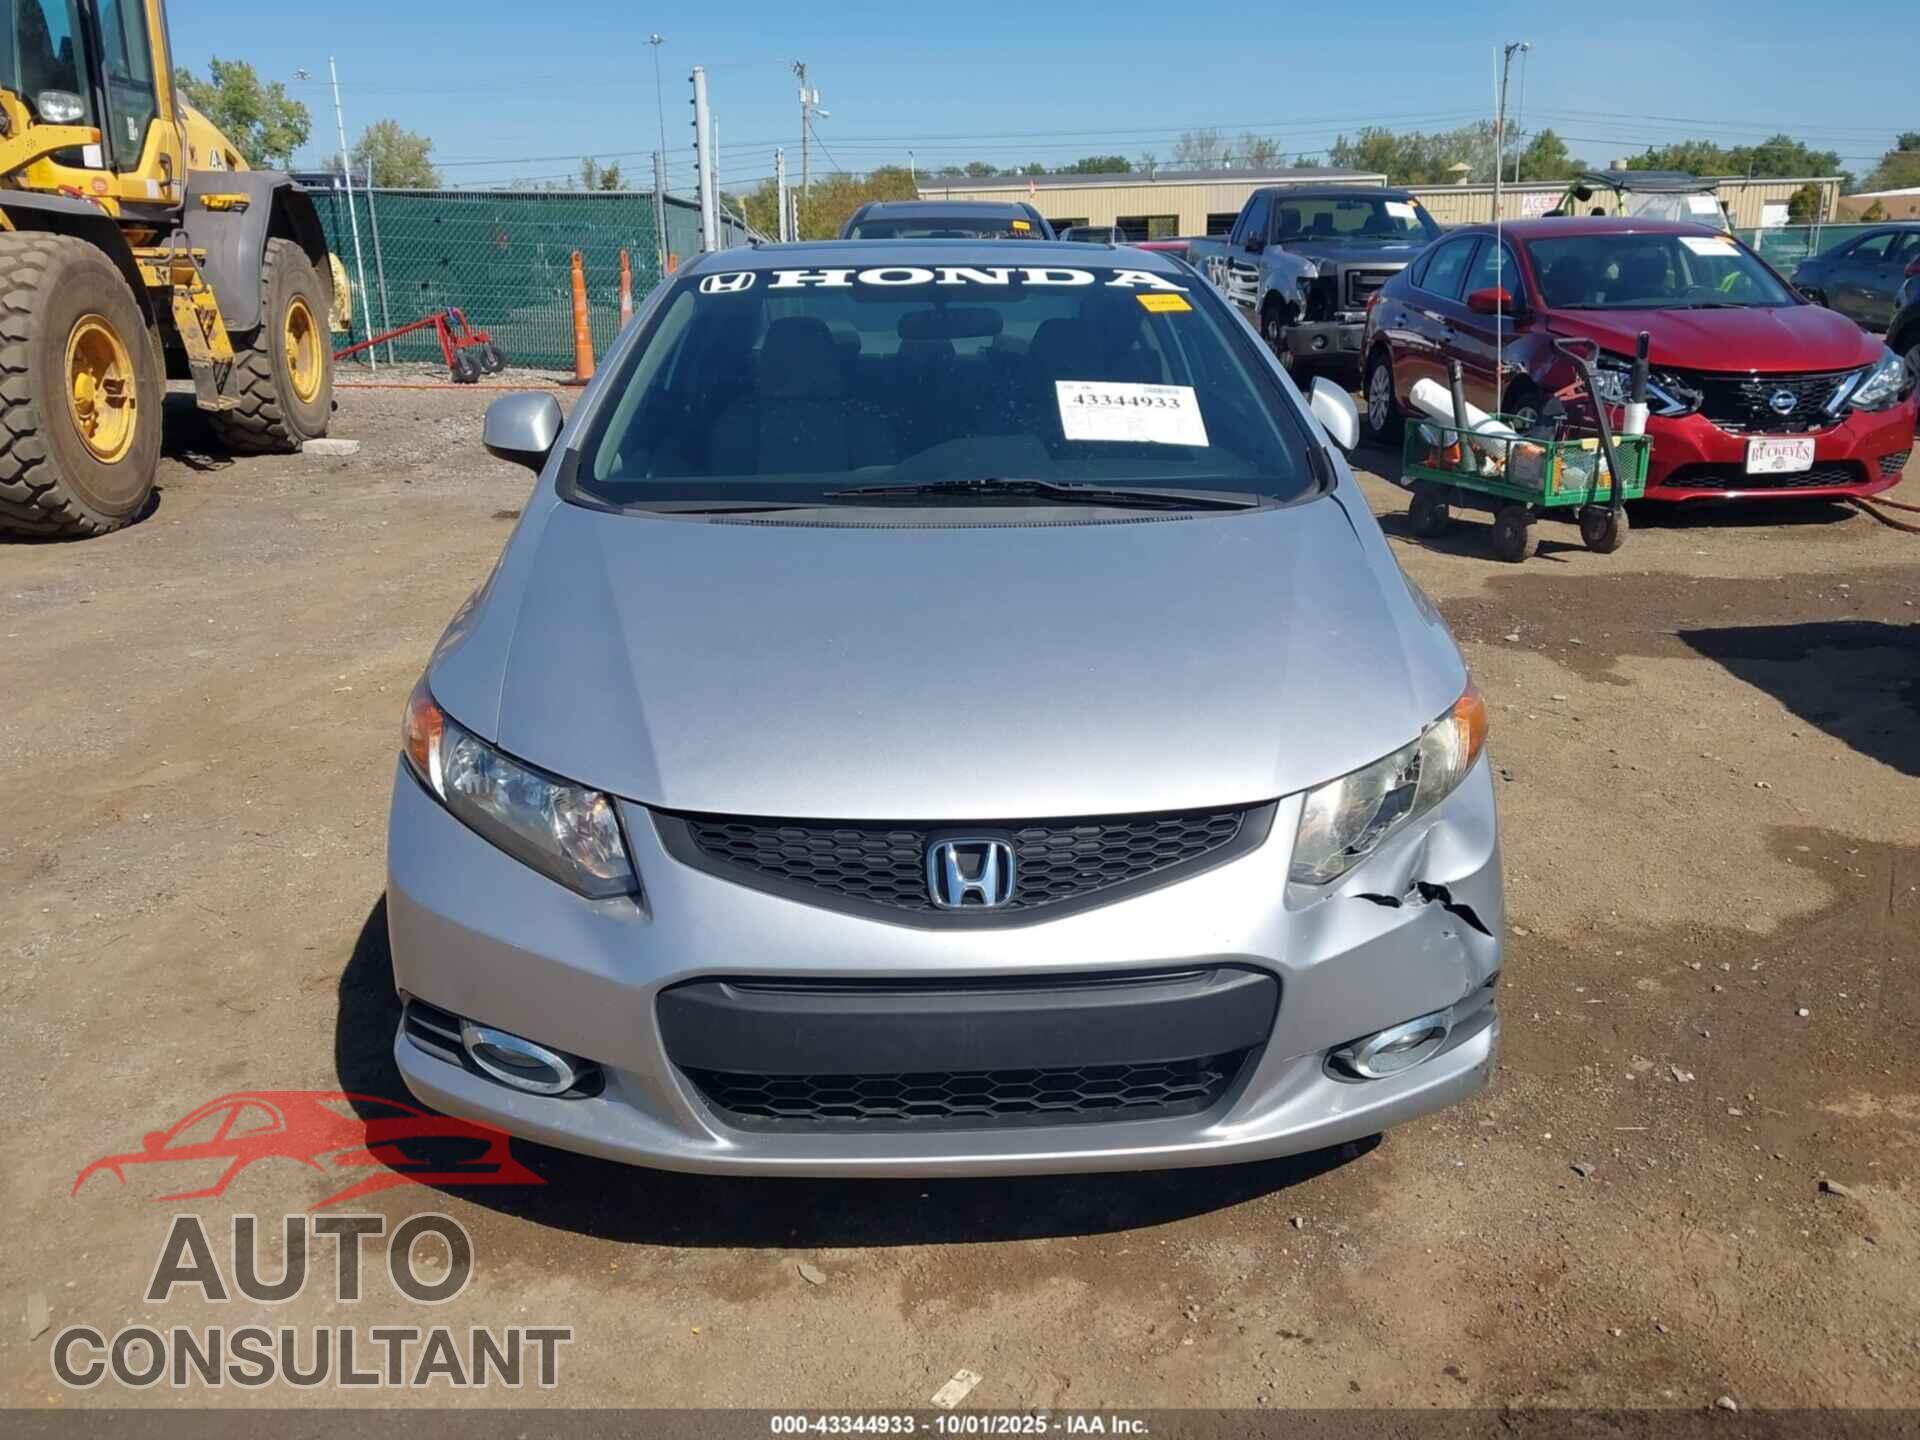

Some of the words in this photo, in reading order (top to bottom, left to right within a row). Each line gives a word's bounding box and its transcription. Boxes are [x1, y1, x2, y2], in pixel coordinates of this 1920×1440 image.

[768, 267, 1190, 292] HONDA
[1073, 393, 1181, 409] 43344933
[1752, 446, 1810, 461] BUCKEYES
